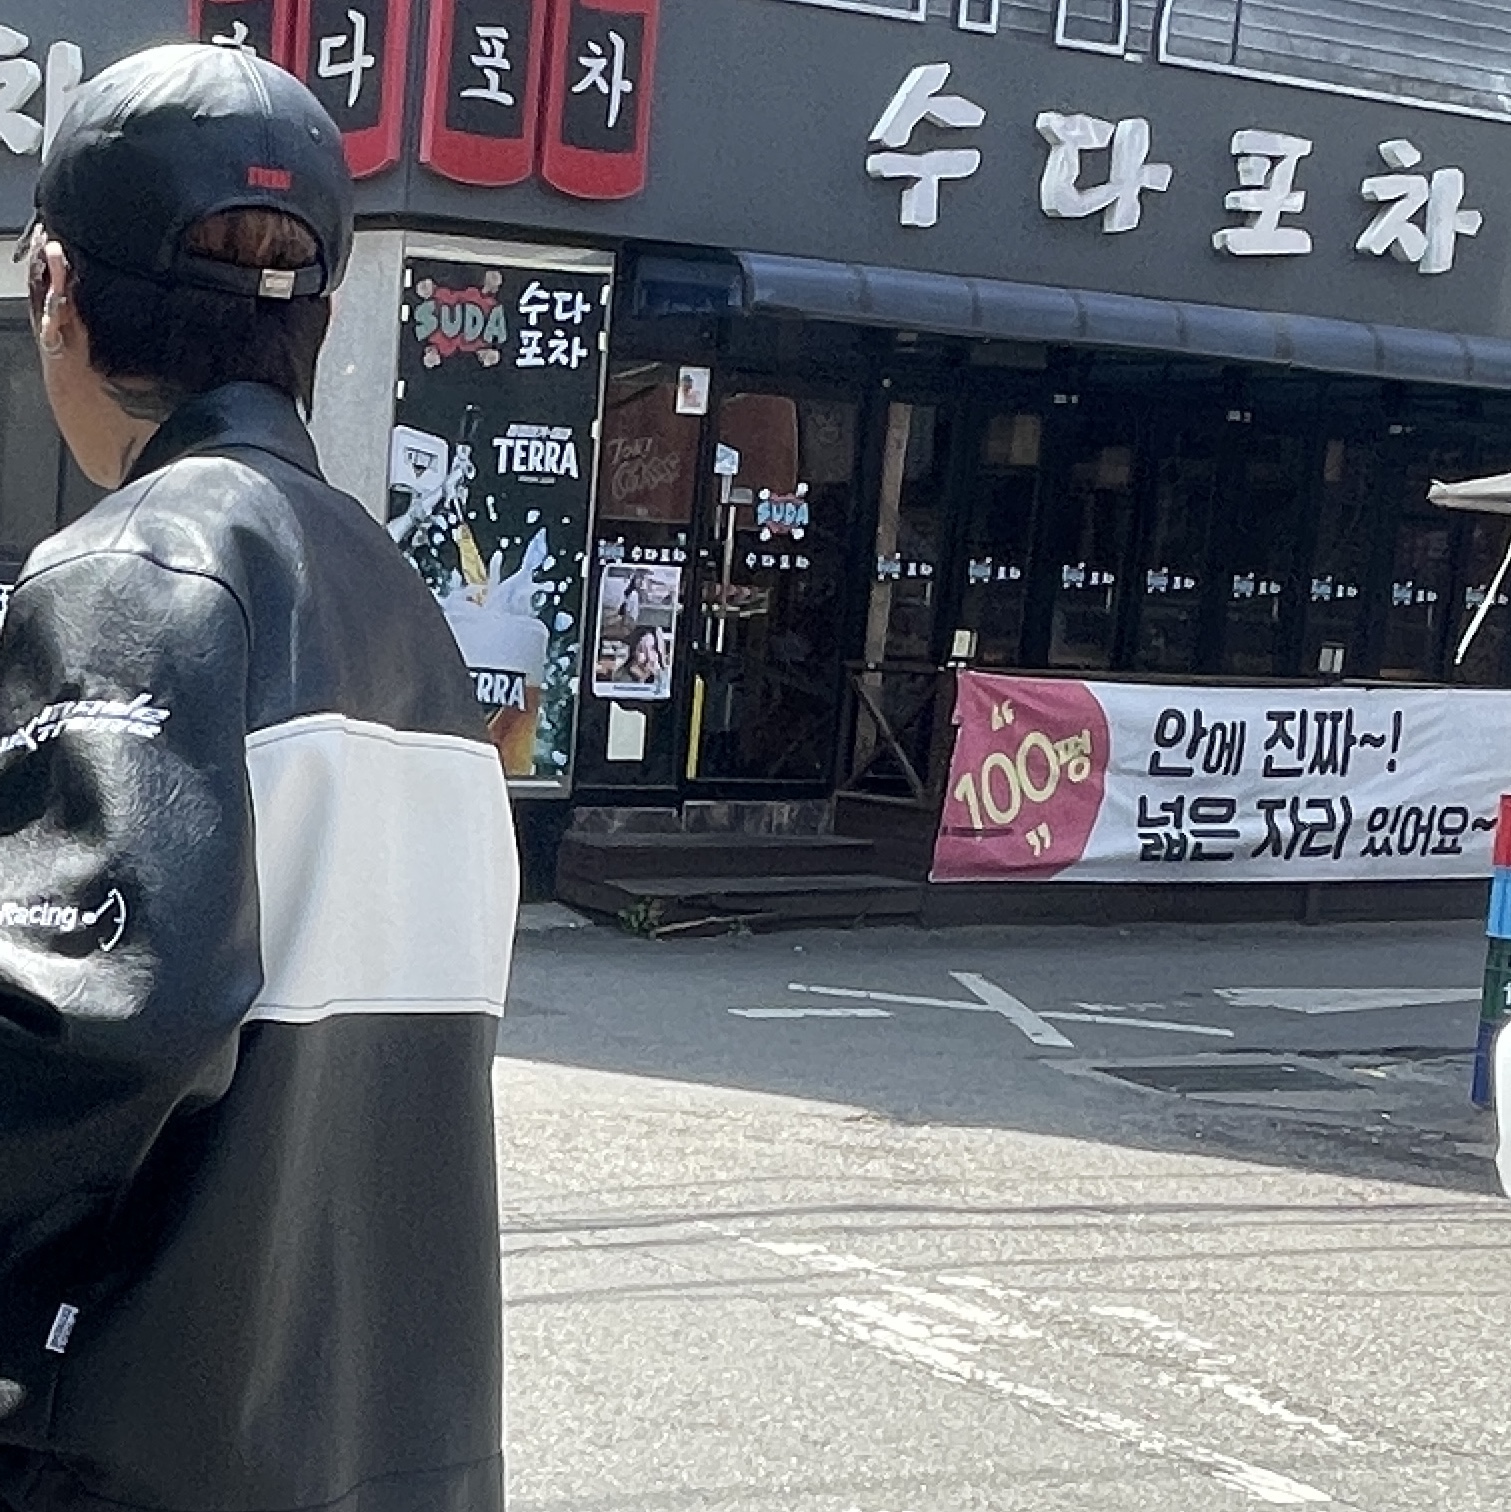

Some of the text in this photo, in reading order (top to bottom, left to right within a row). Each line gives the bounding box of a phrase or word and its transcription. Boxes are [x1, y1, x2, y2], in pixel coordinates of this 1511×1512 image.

[864, 61, 1484, 275] 수다포차
[414, 299, 508, 343] SUDA
[519, 280, 592, 327] 수다
[515, 329, 589, 370] 포차
[492, 437, 580, 480] TERRA
[469, 671, 526, 711] RRA
[1147, 707, 1247, 778] 안에
[954, 729, 1094, 831] 100평
[1137, 794, 1242, 862] 넓은
[1251, 796, 1353, 861] 자리
